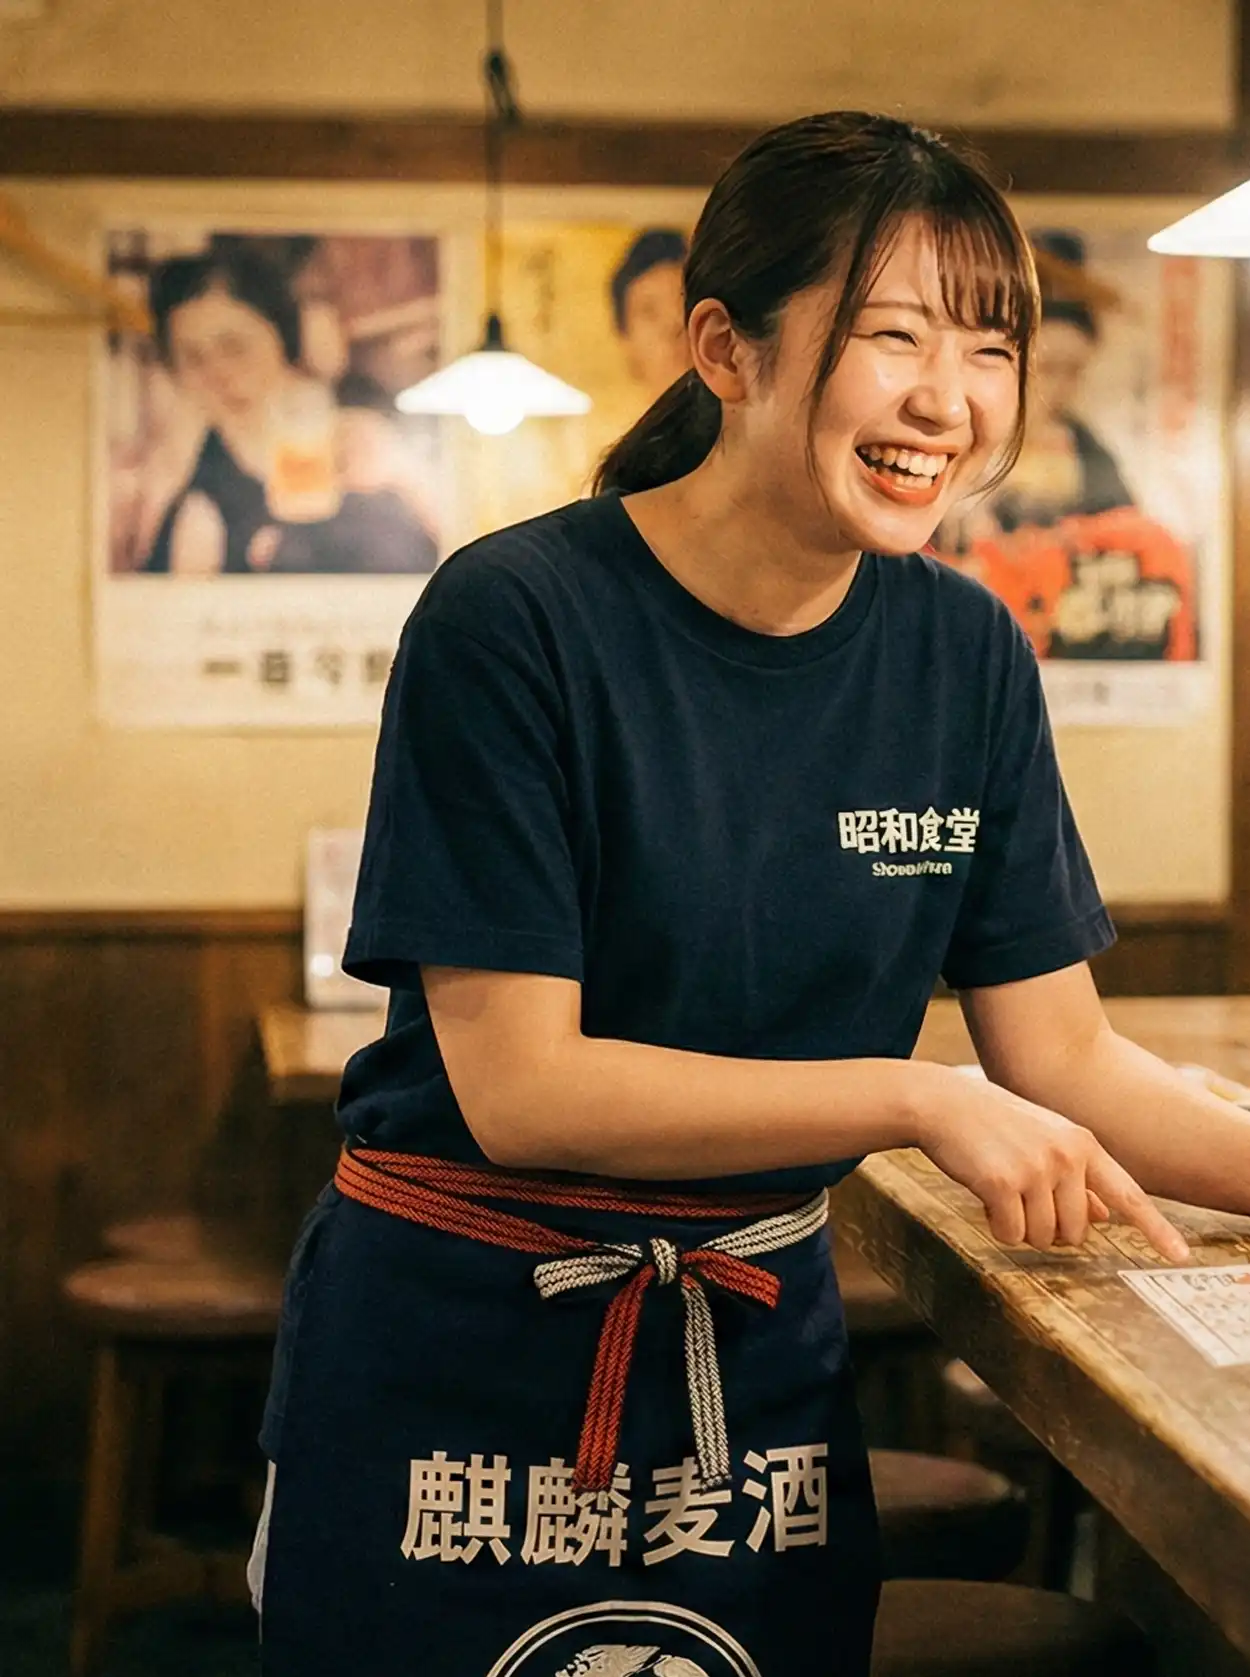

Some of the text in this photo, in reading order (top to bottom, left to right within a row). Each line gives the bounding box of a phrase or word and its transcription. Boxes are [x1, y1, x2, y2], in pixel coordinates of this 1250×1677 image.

[837, 806, 980, 854] 昭和食堂
[400, 1443, 829, 1567] 麒麟麦酒
